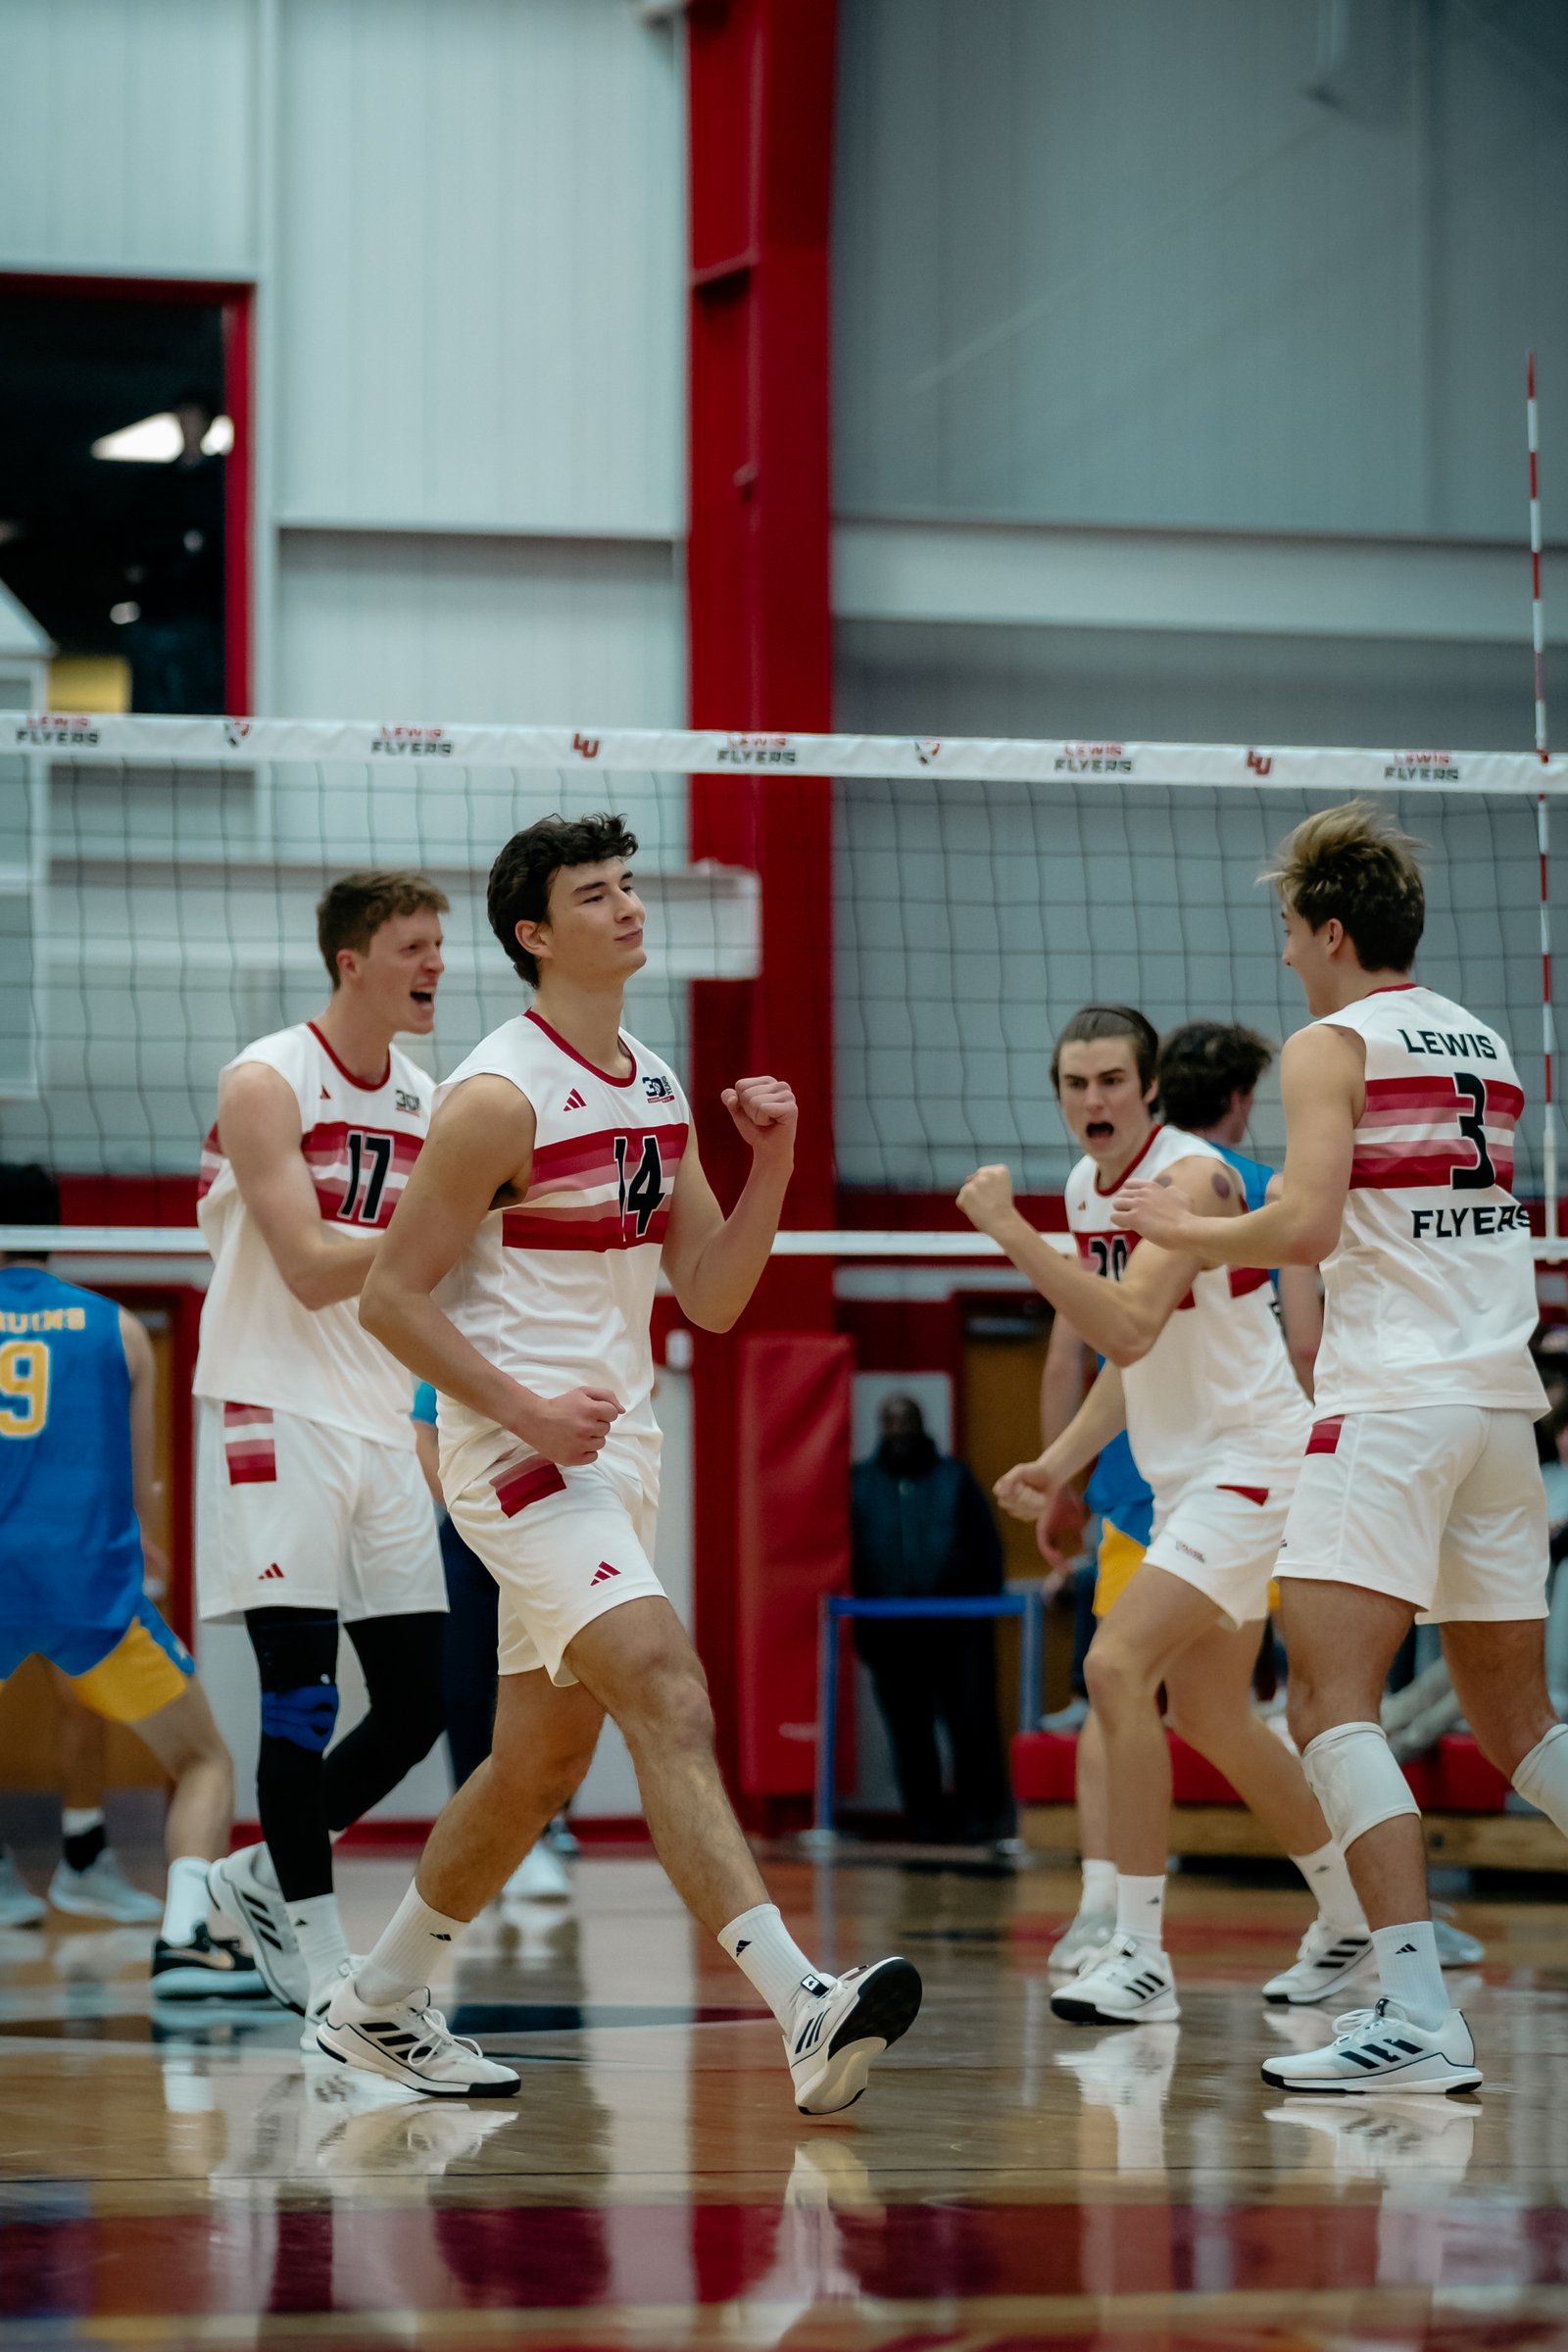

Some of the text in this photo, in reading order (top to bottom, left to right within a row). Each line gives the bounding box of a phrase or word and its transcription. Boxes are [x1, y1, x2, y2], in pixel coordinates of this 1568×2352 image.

[16, 730, 99, 746] FLYERS
[371, 741, 452, 756] FLYERS
[573, 733, 599, 758] LU
[717, 749, 796, 763] FLYERS
[1054, 759, 1133, 774] FLYERS
[1247, 751, 1271, 775] LU
[1384, 766, 1458, 782] FLYERS
[1397, 1029, 1497, 1059] LEWIS
[1450, 1071, 1495, 1191] 3
[338, 1131, 394, 1223] 17
[613, 1133, 667, 1242] 14
[1411, 1204, 1531, 1239] FLYERS
